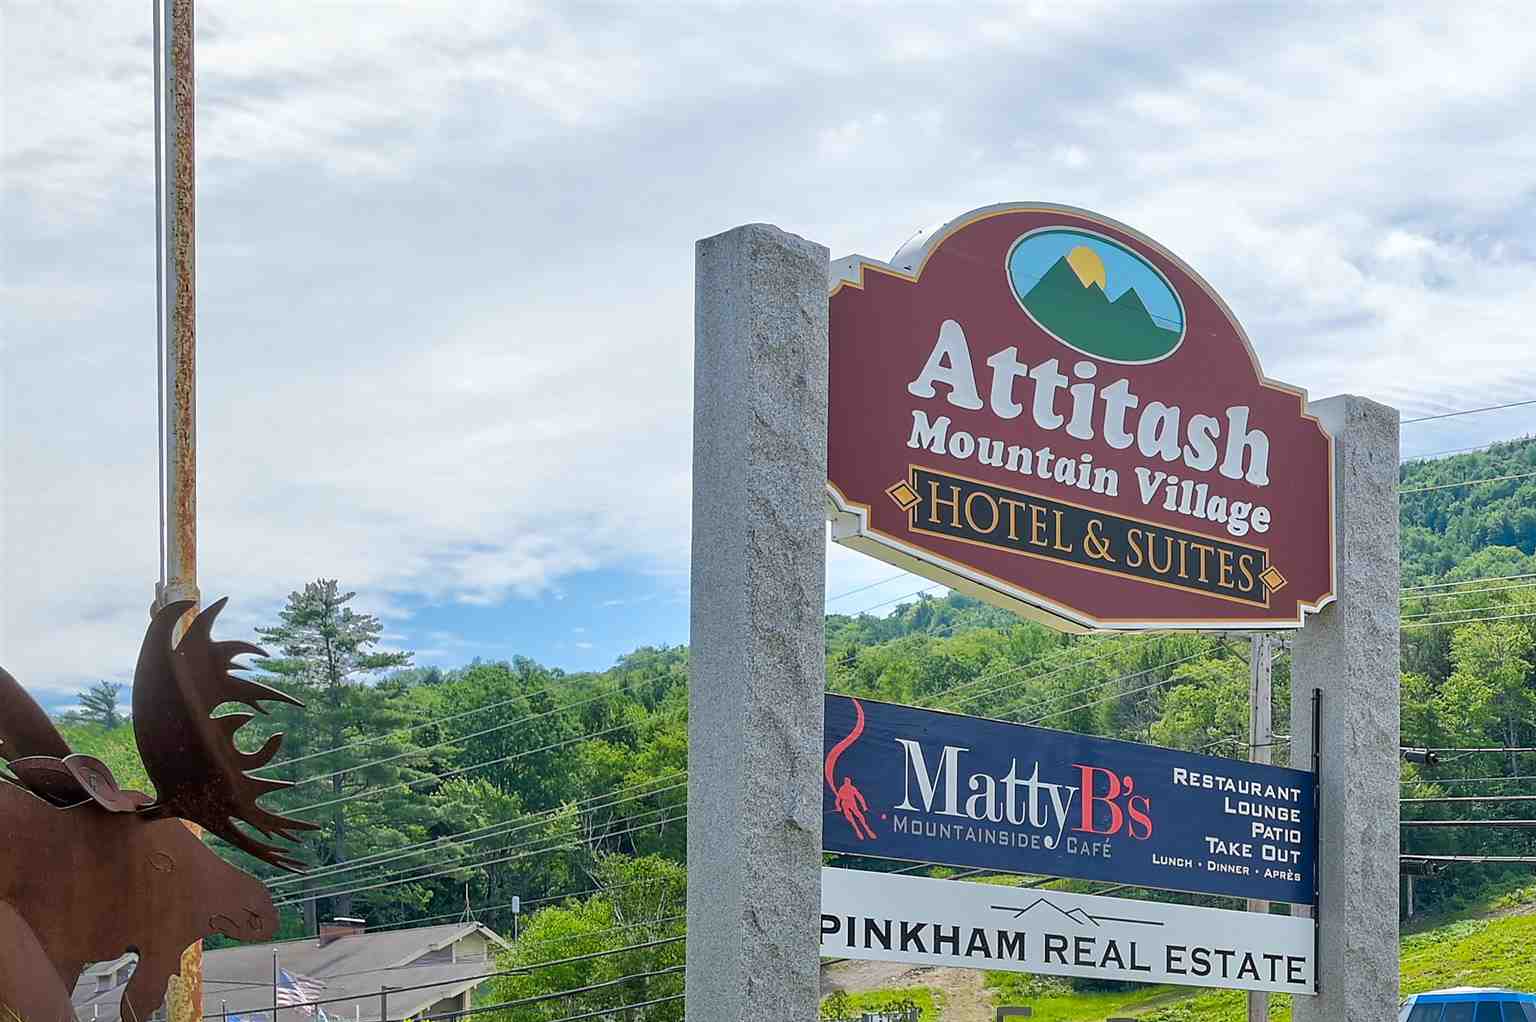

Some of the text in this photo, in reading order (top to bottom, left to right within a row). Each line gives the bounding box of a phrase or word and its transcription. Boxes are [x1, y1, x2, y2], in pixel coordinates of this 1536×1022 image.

[907, 319, 1271, 487] Attitash
[906, 409, 1272, 536] Mountain Village
[928, 480, 1254, 593] HOTEL & SUITES
[1173, 767, 1301, 802] RESTAURANT
[1224, 797, 1301, 823] LOUNGE
[893, 815, 1112, 859] MOUNTAINSIDE CAFÉ
[1205, 836, 1301, 864] TAKE OUT
[1252, 822, 1301, 844] PATIO
[1152, 853, 1193, 868] LUNCH
[1207, 860, 1250, 876] DINNER
[820, 913, 1306, 985] PINKHAM REAL ESTATE
